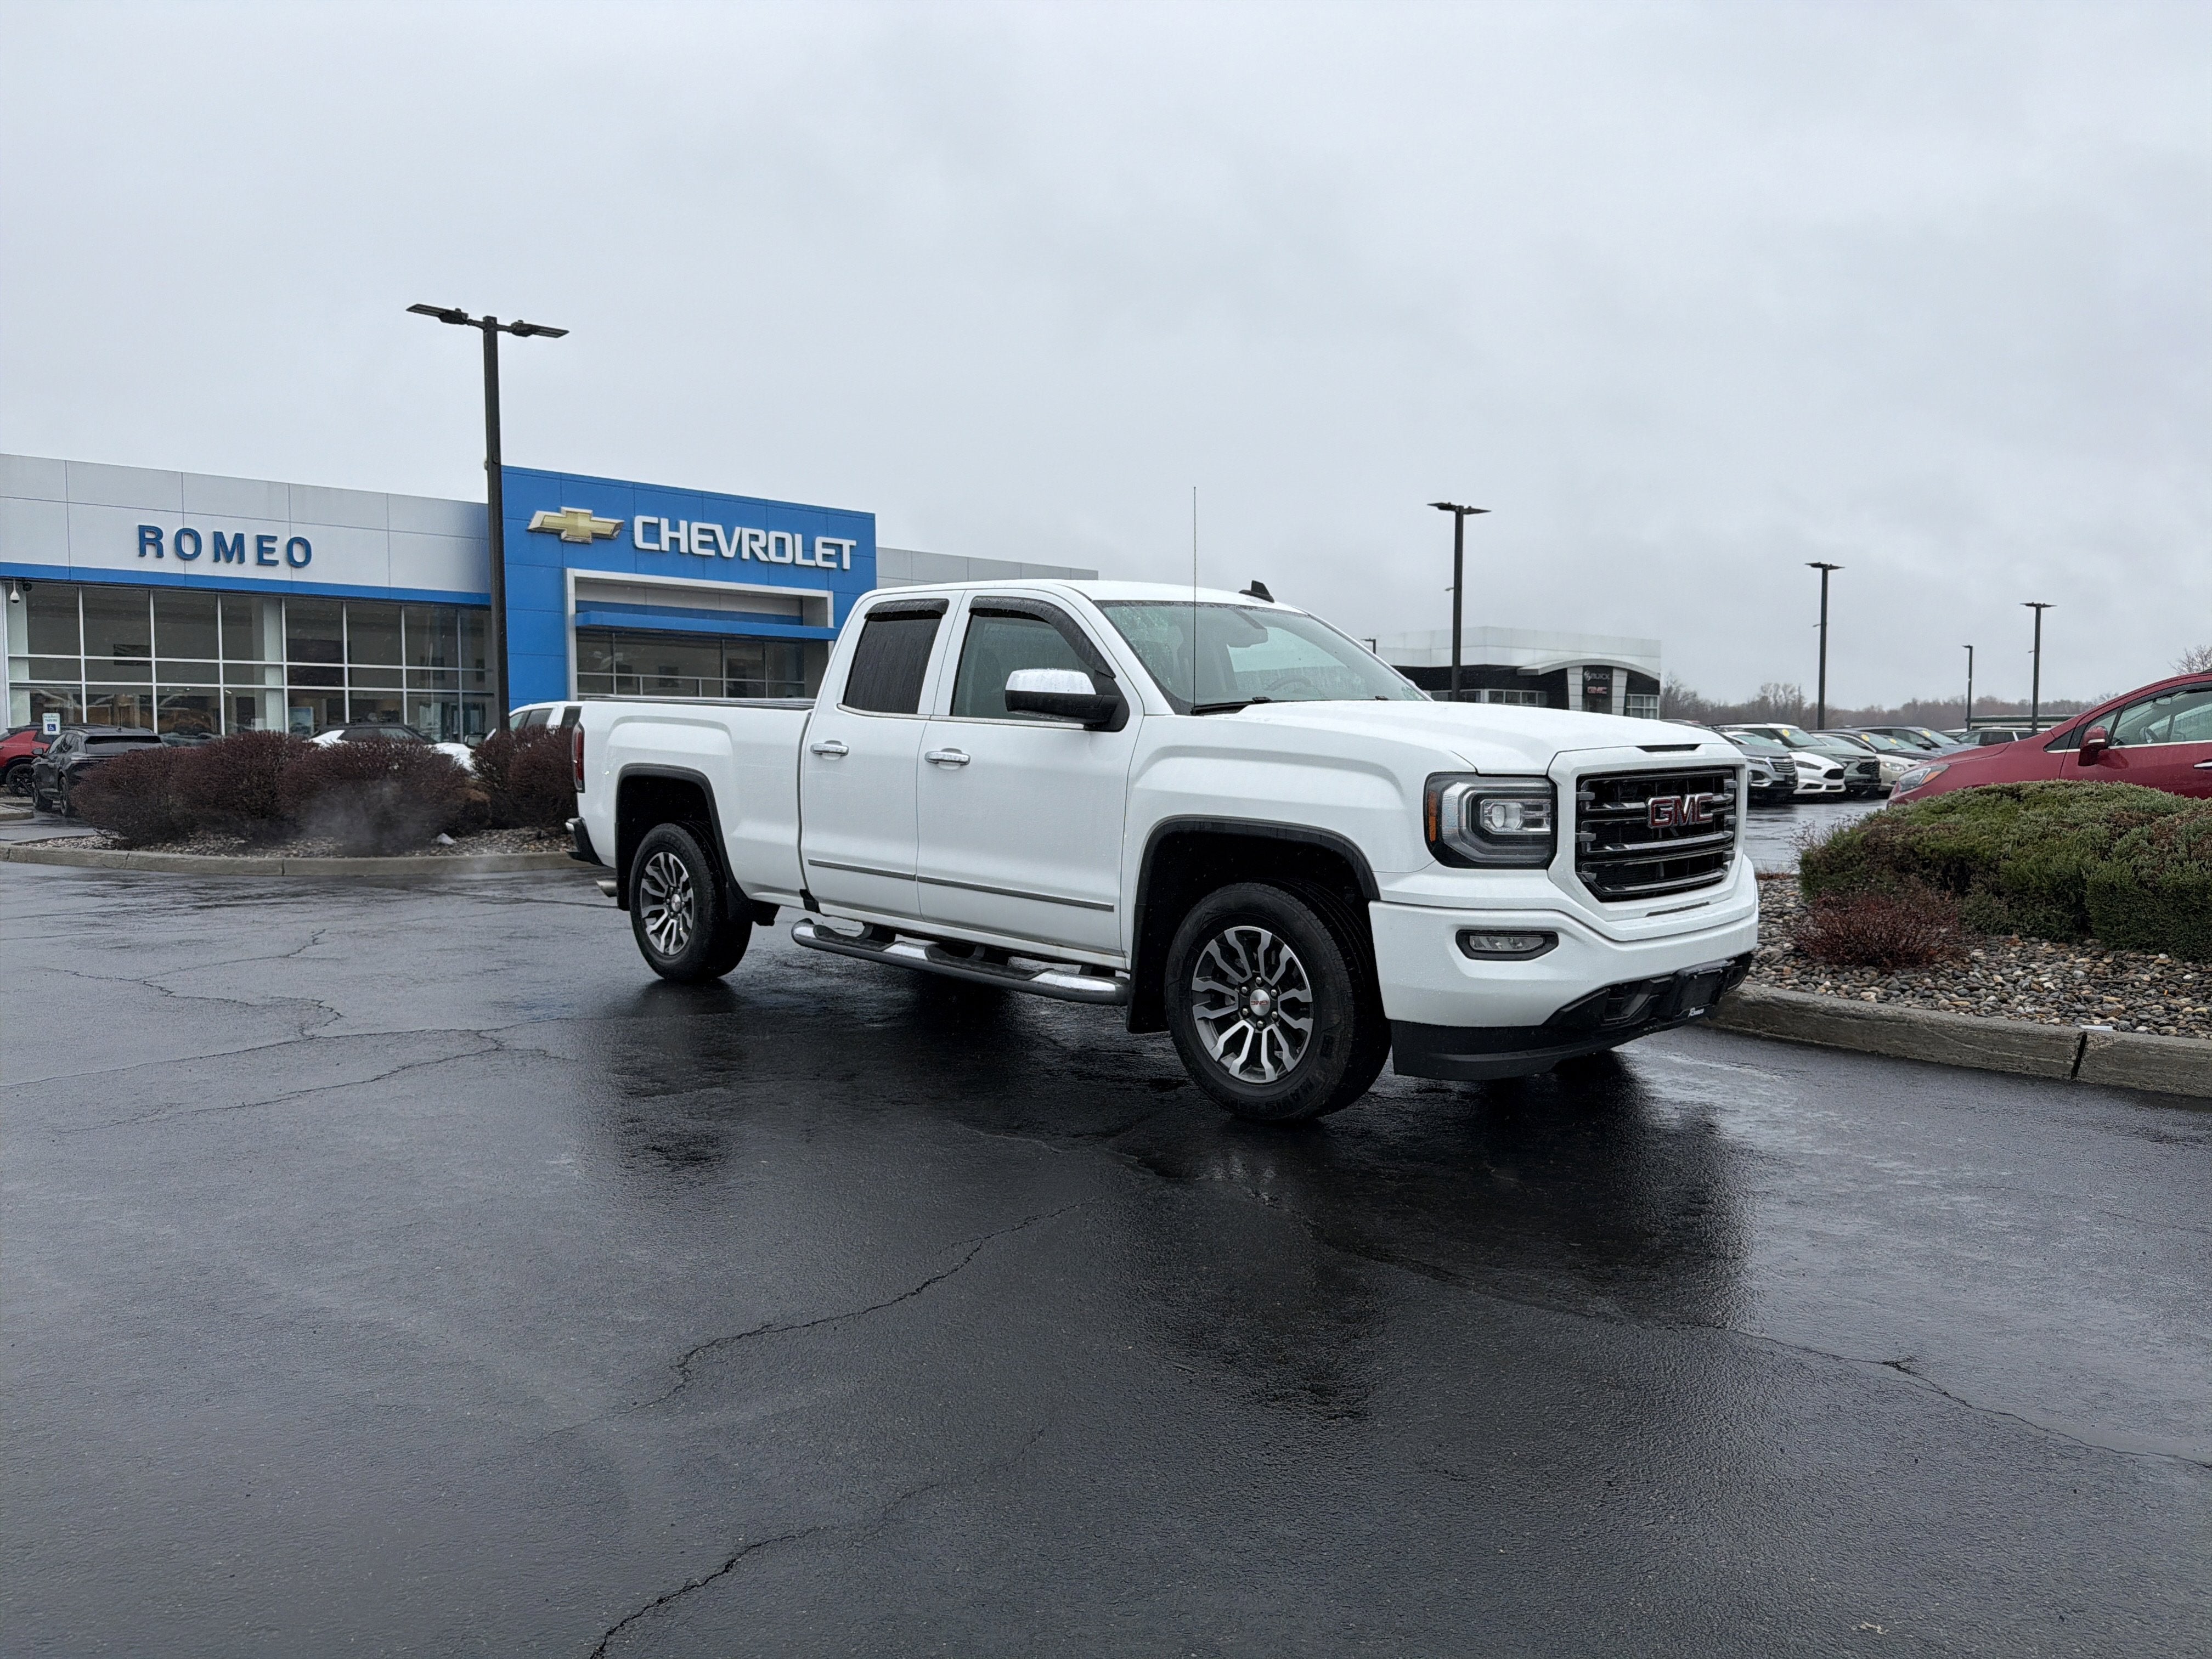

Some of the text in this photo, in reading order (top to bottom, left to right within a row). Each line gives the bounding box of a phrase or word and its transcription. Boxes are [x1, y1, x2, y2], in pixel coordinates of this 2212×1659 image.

[138, 524, 312, 568] ROMEO
[634, 515, 856, 569] CHEVROLET
[1647, 793, 1713, 828] GMC
